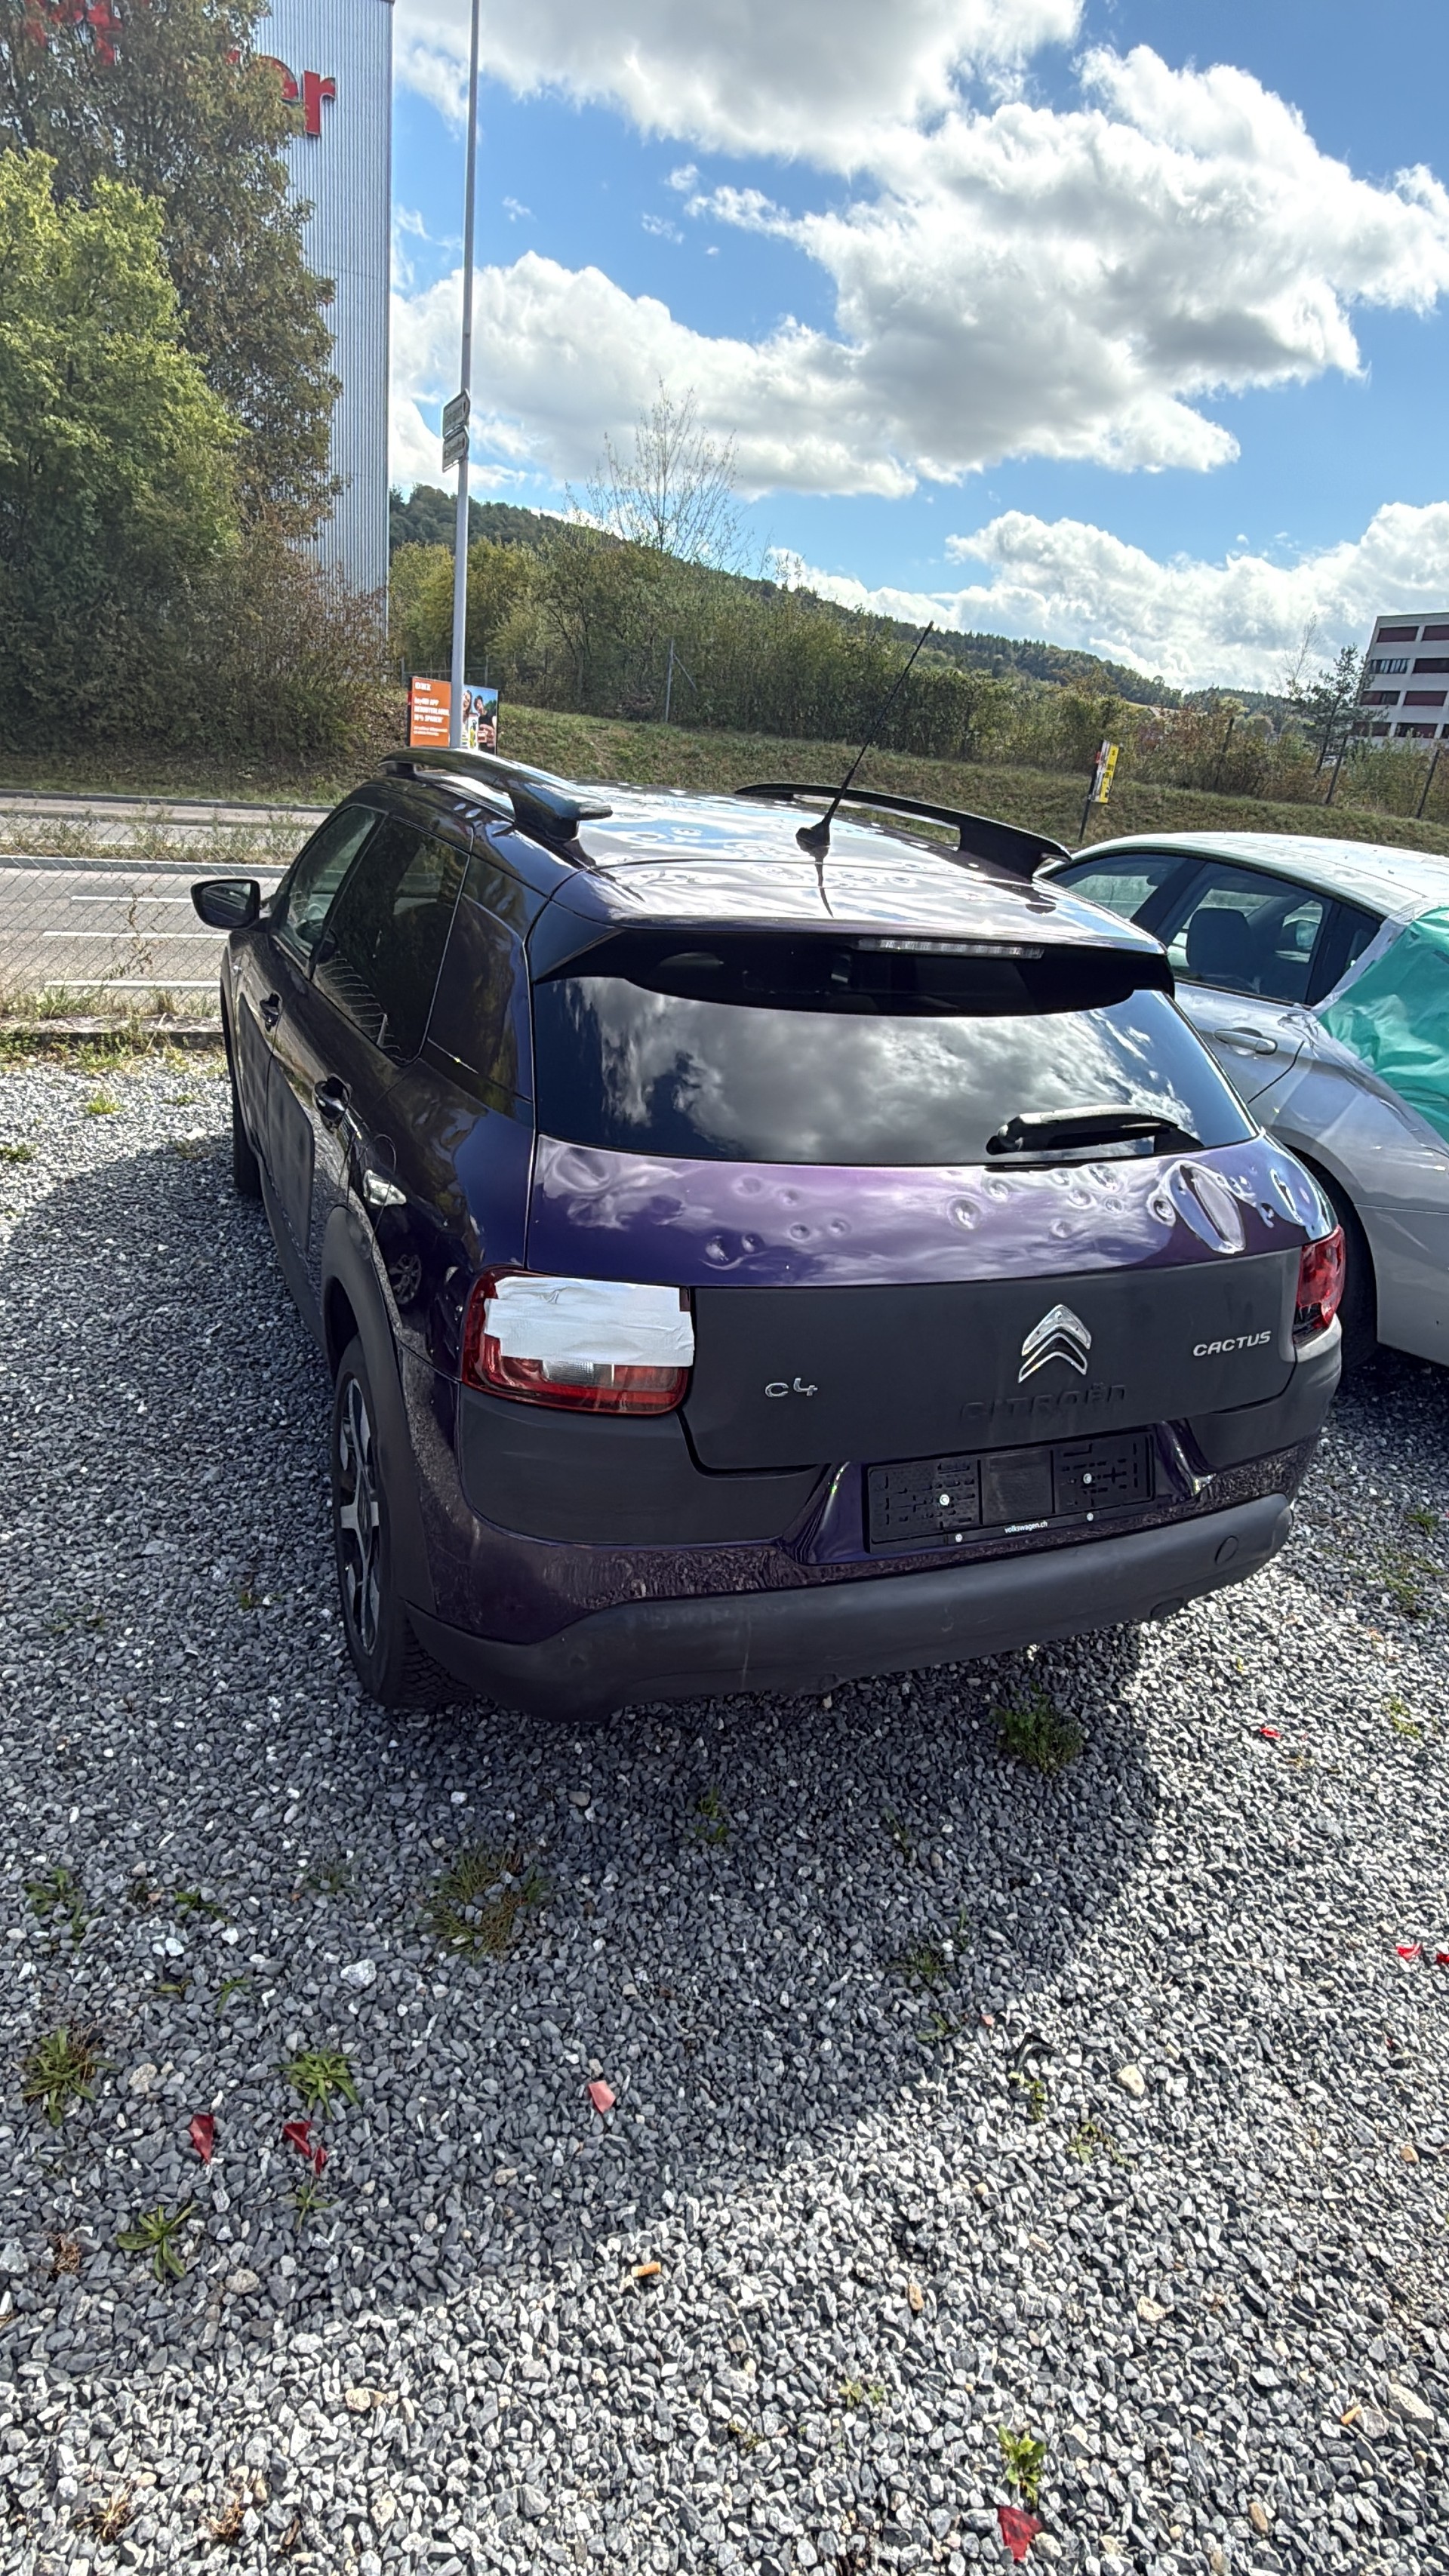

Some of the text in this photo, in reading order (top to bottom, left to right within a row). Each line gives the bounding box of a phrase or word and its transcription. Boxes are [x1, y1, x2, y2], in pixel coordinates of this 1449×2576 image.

[1193, 1331, 1272, 1356] CACTUS
[765, 1377, 818, 1397] C4
[1004, 1520, 1048, 1534] volkswagen.ch
